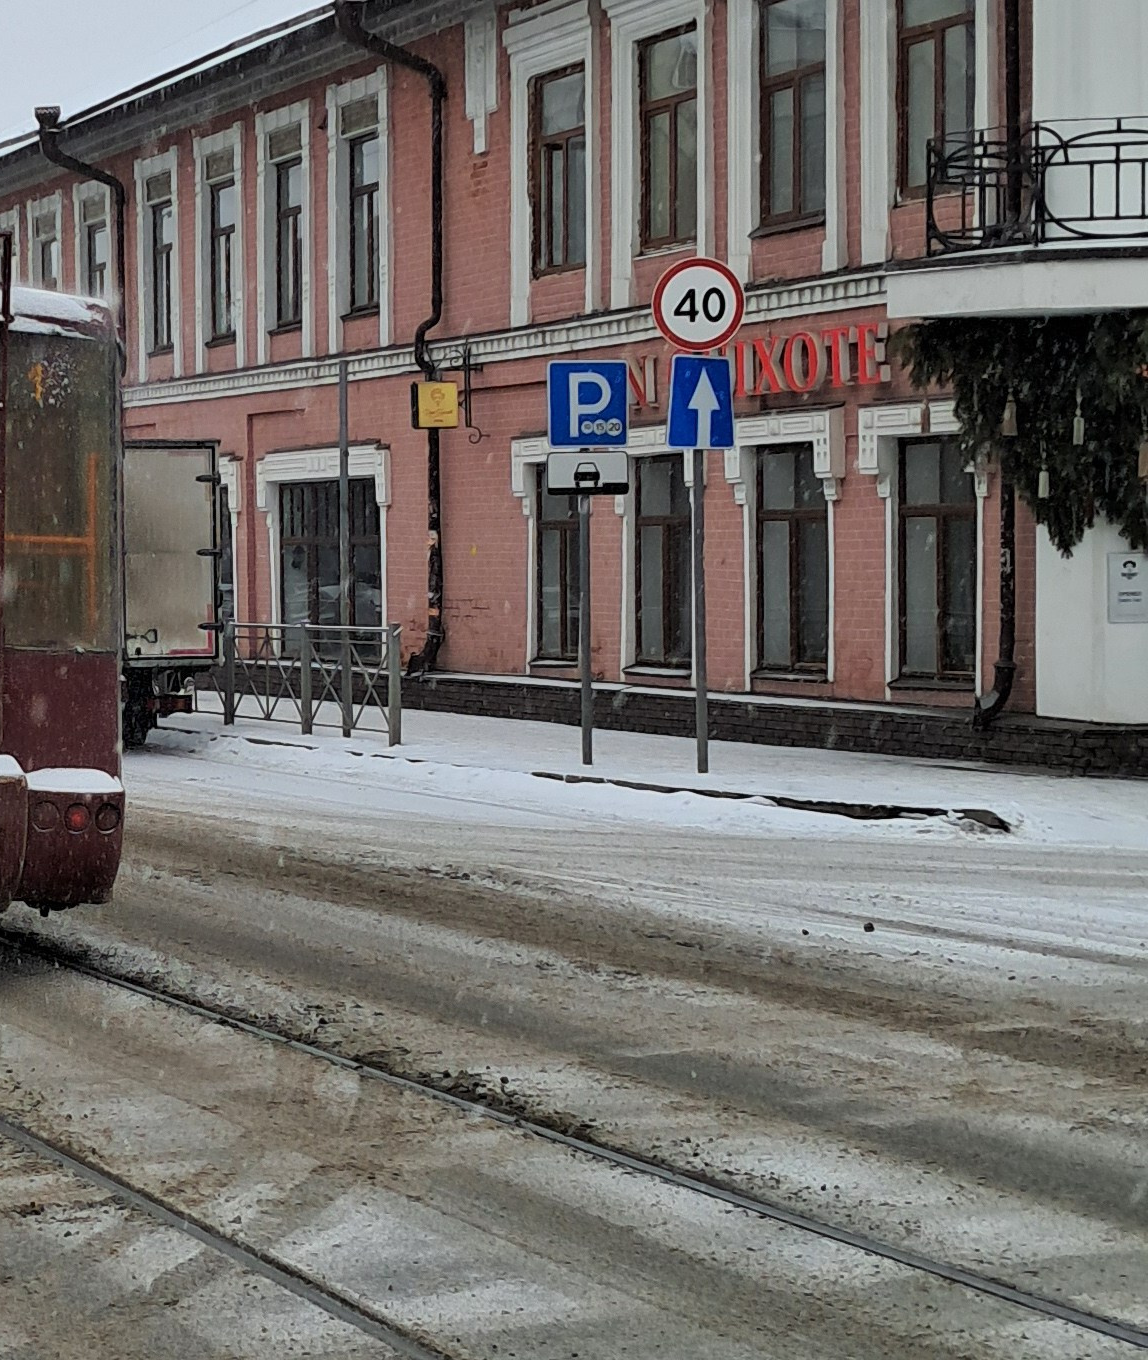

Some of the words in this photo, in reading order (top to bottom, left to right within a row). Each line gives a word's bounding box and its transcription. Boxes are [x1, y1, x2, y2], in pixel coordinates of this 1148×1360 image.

[673, 286, 726, 323] 40
[668, 323, 889, 398] IXOTE
[568, 371, 612, 438] P
[595, 422, 605, 431] 15
[608, 422, 621, 432] 20
